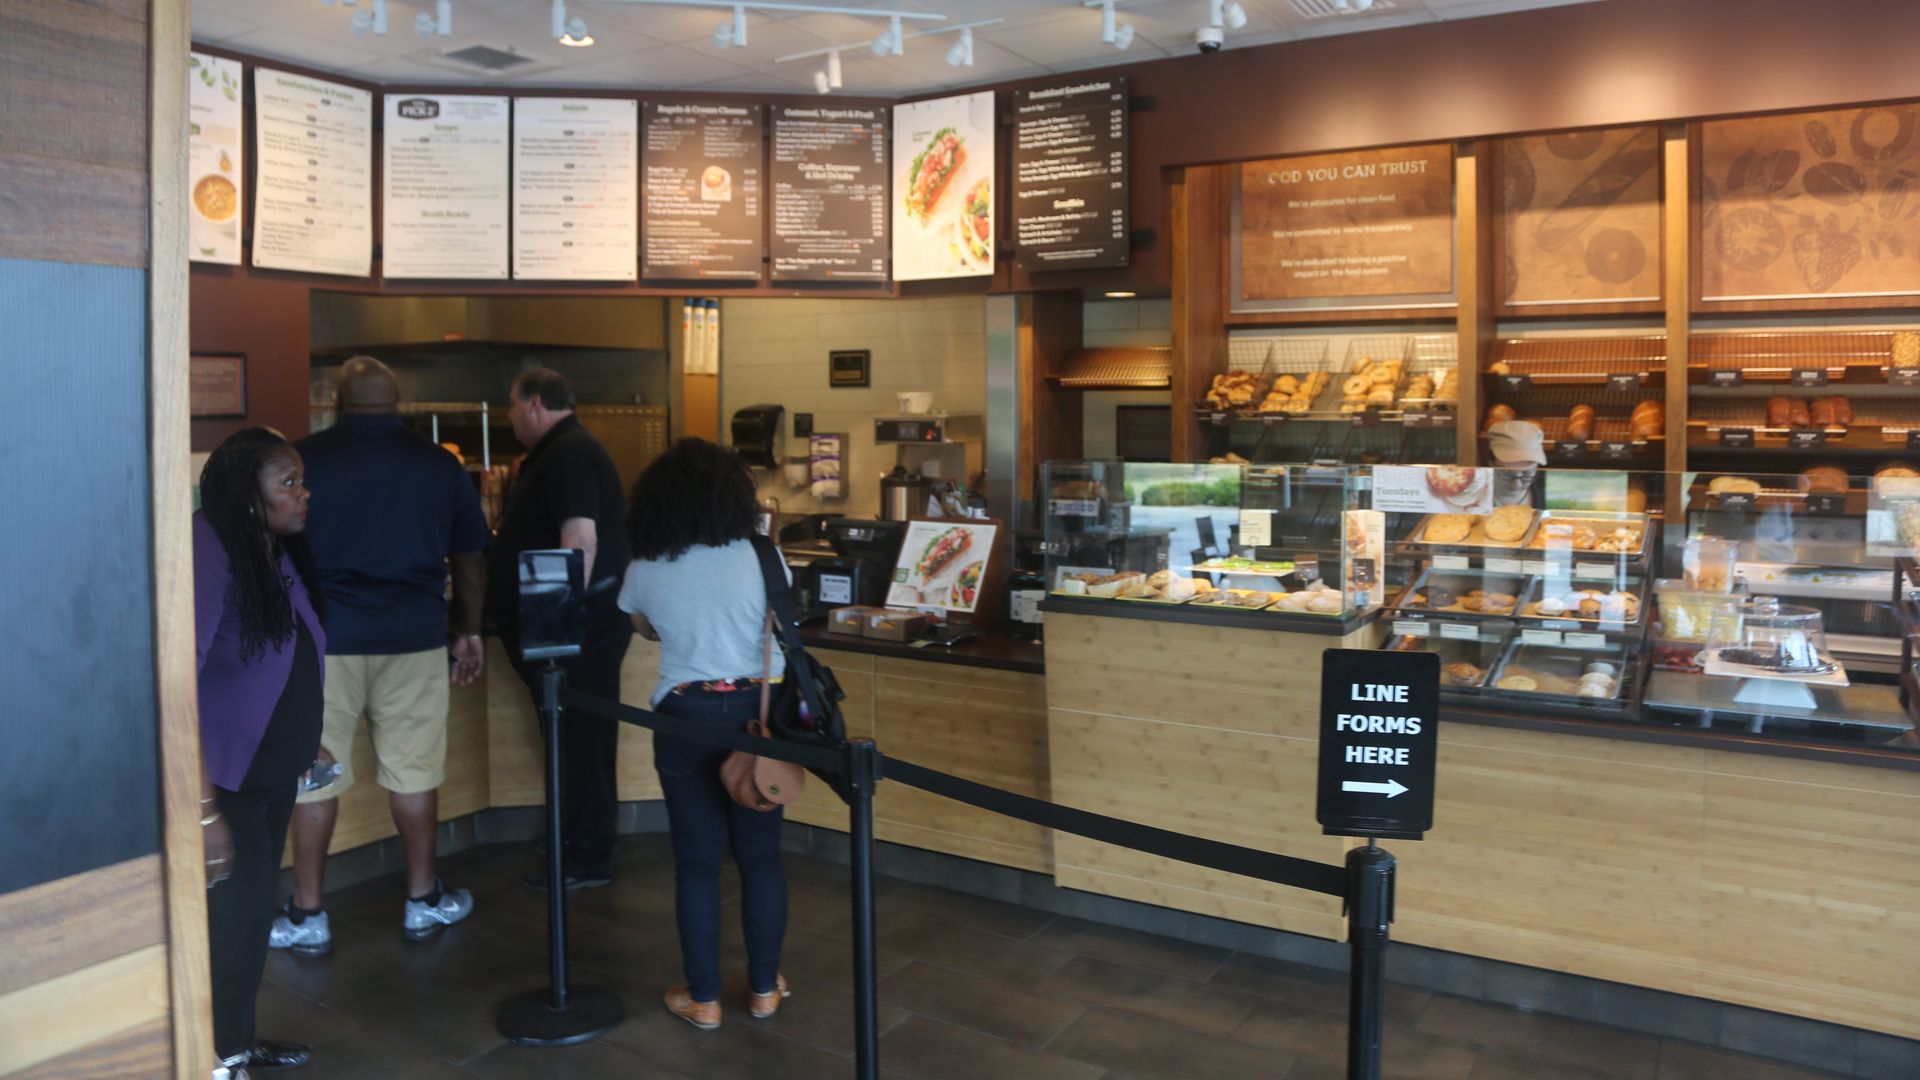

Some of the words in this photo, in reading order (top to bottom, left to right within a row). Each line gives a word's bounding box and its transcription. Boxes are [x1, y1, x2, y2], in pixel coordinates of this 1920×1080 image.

[1028, 87, 1065, 100] Breakfast
[1065, 82, 1111, 95] Sandwiches
[1307, 167, 1338, 182] YOU
[1343, 163, 1376, 180] CAN
[1381, 160, 1428, 176] TRUST
[1376, 487, 1420, 496] Tuesdays
[1351, 683, 1409, 703] LINE
[1336, 714, 1422, 735] FORMS
[1345, 745, 1410, 765] HERE
